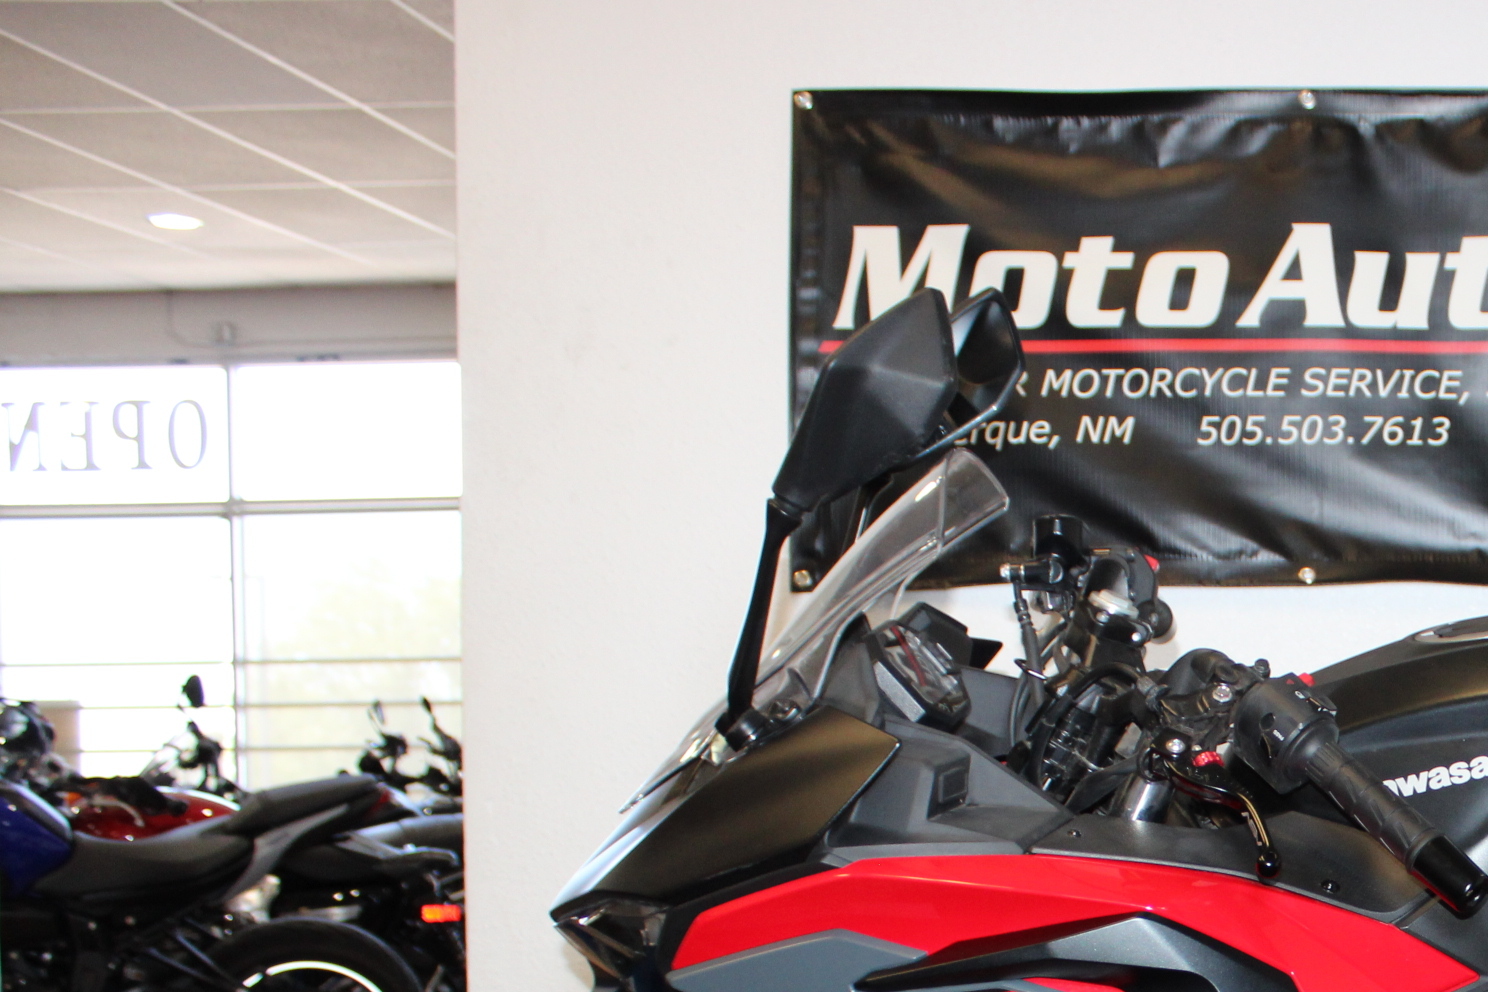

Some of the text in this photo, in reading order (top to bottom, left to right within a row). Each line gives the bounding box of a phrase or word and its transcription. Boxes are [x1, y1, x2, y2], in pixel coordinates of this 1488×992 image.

[1040, 367, 1291, 400] MOTORCYCLE
[1301, 369, 1470, 405] SERVICE,
[954, 418, 1060, 451] rque,
[1075, 415, 1135, 445] NM
[1197, 415, 1451, 446] 505.503.7613
